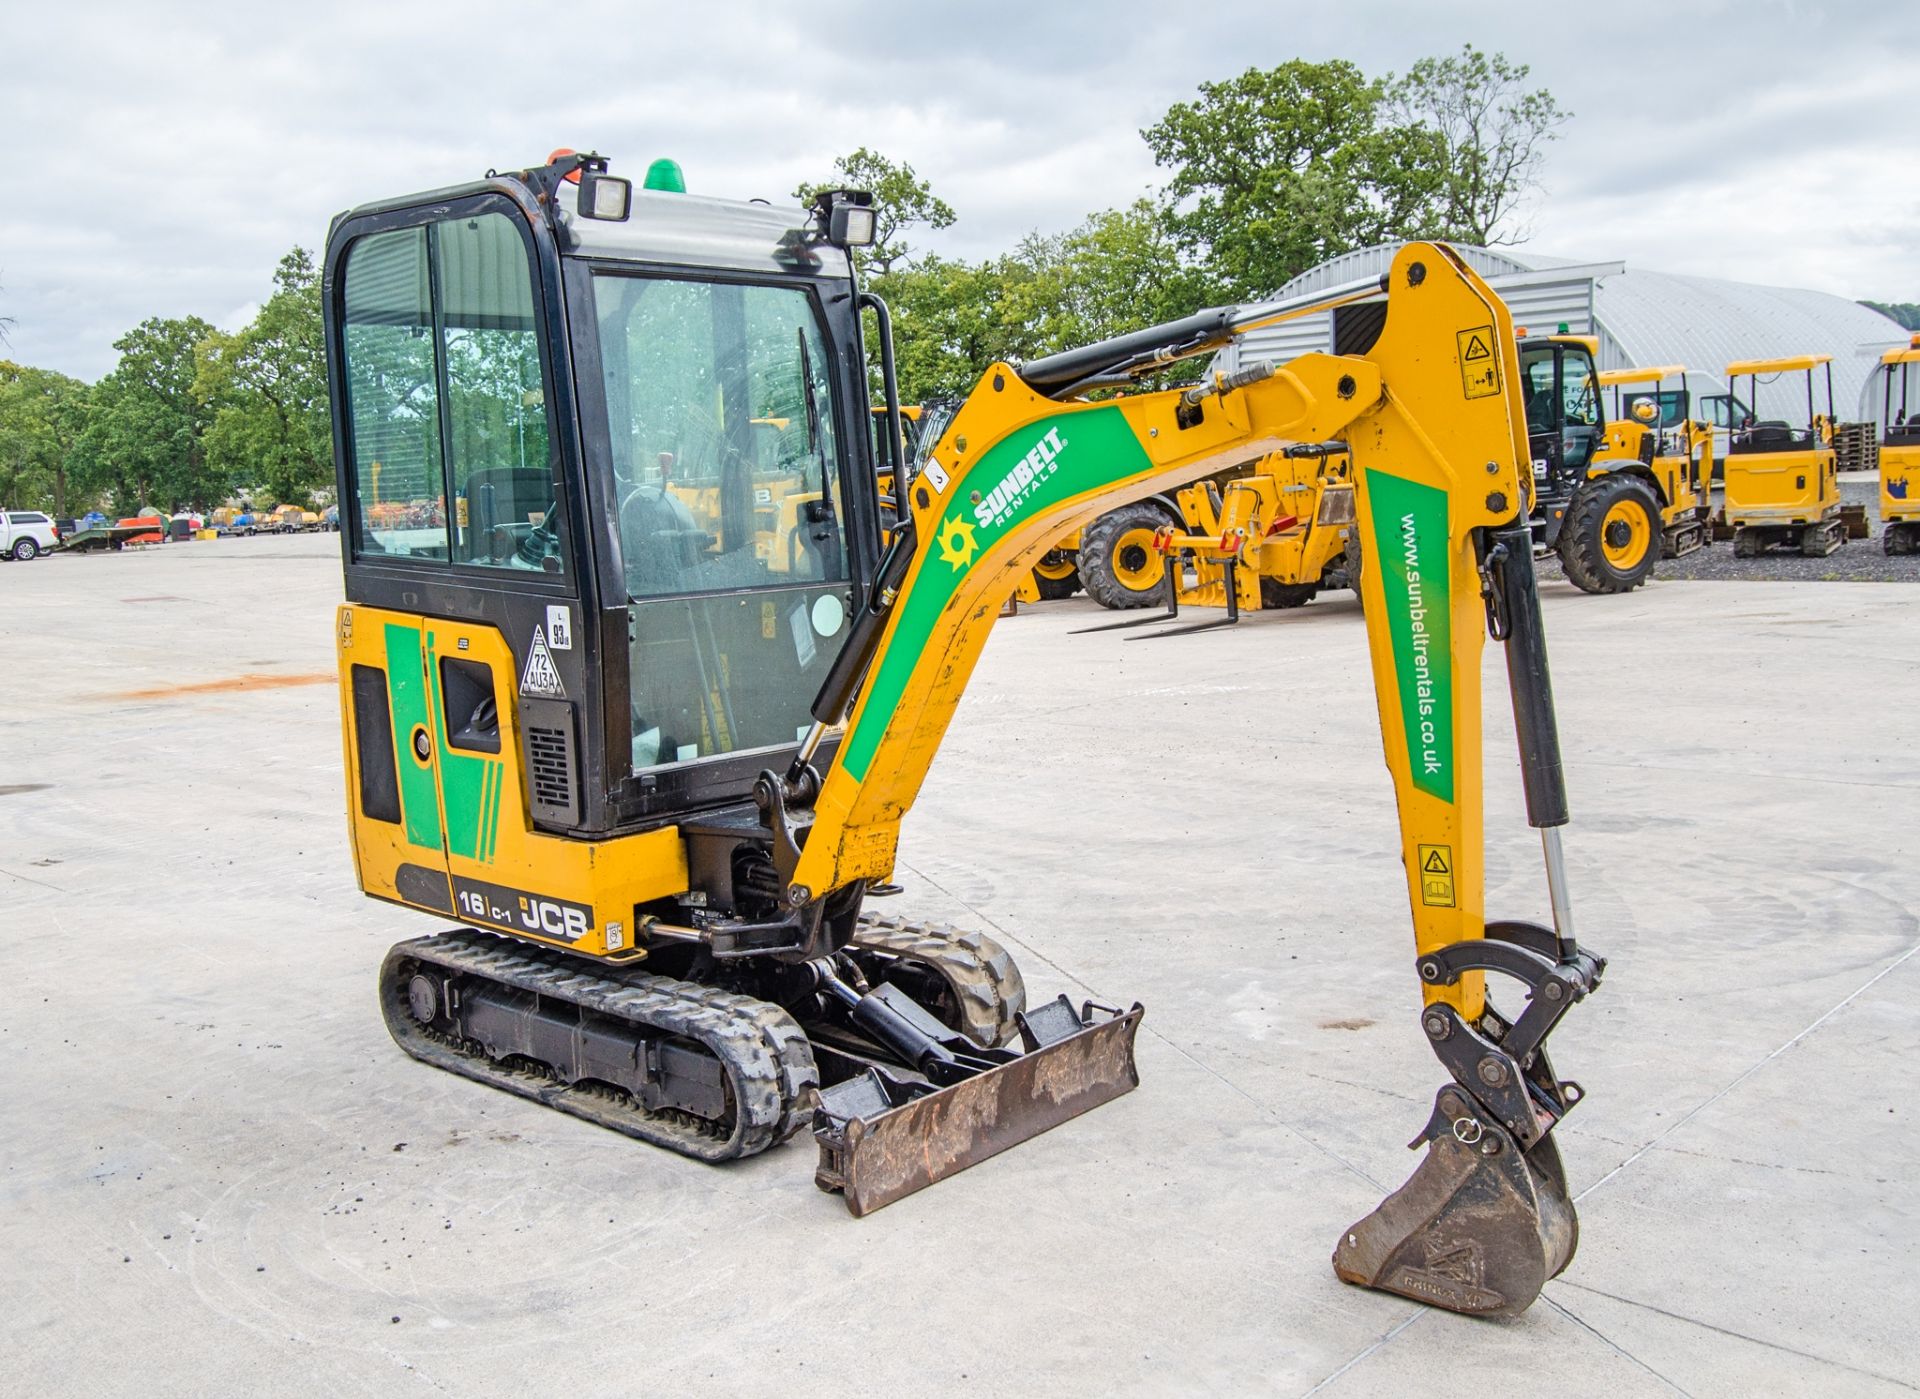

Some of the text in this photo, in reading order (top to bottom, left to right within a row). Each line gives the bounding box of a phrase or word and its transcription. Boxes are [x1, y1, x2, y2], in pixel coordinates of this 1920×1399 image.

[974, 426, 1063, 529] SUNBELT
[995, 461, 1058, 527] RENTALS
[534, 653, 547, 671] 72
[1401, 513, 1442, 775] www.sunbeltrentals.co.uk
[459, 890, 485, 916] 16
[519, 898, 588, 939] JCB
